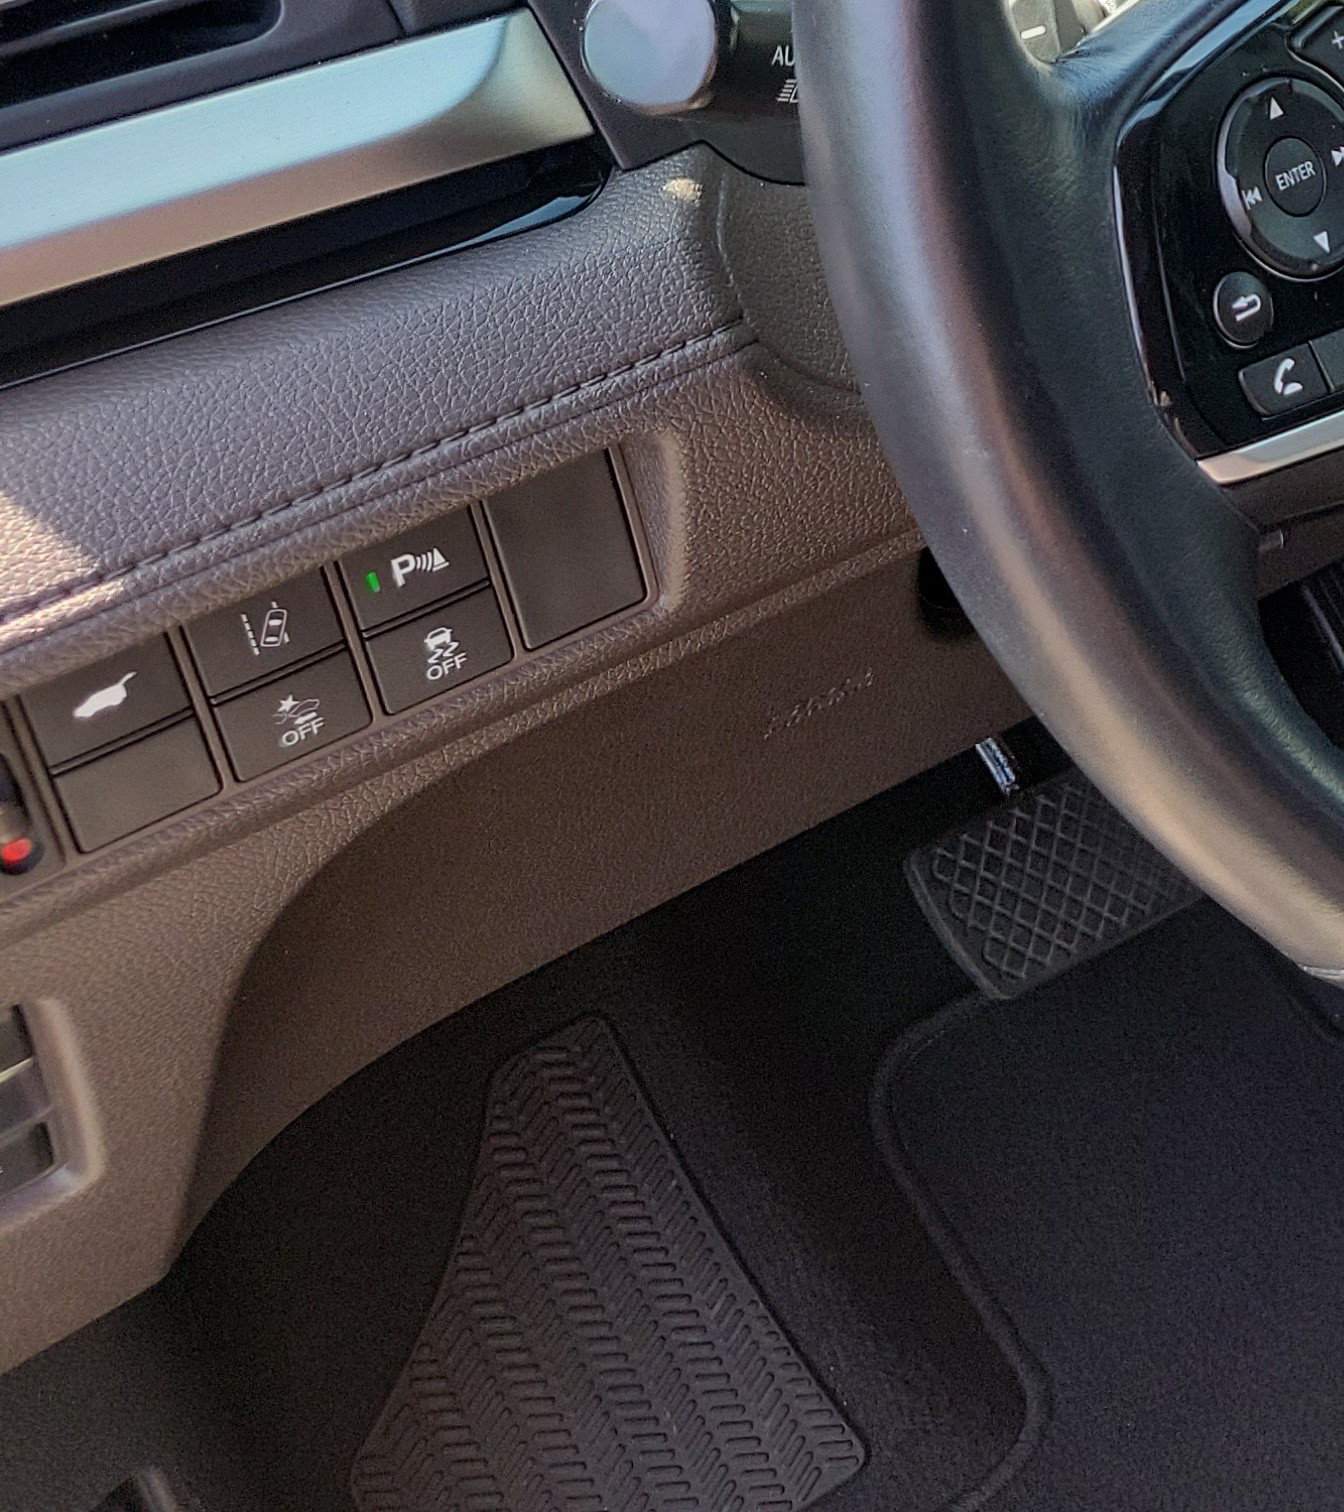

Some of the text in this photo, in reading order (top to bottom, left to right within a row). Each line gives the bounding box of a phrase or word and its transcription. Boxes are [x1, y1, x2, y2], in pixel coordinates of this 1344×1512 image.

[1274, 160, 1316, 192] ENTER
[425, 650, 468, 683] OFF
[280, 716, 326, 749] OFF
